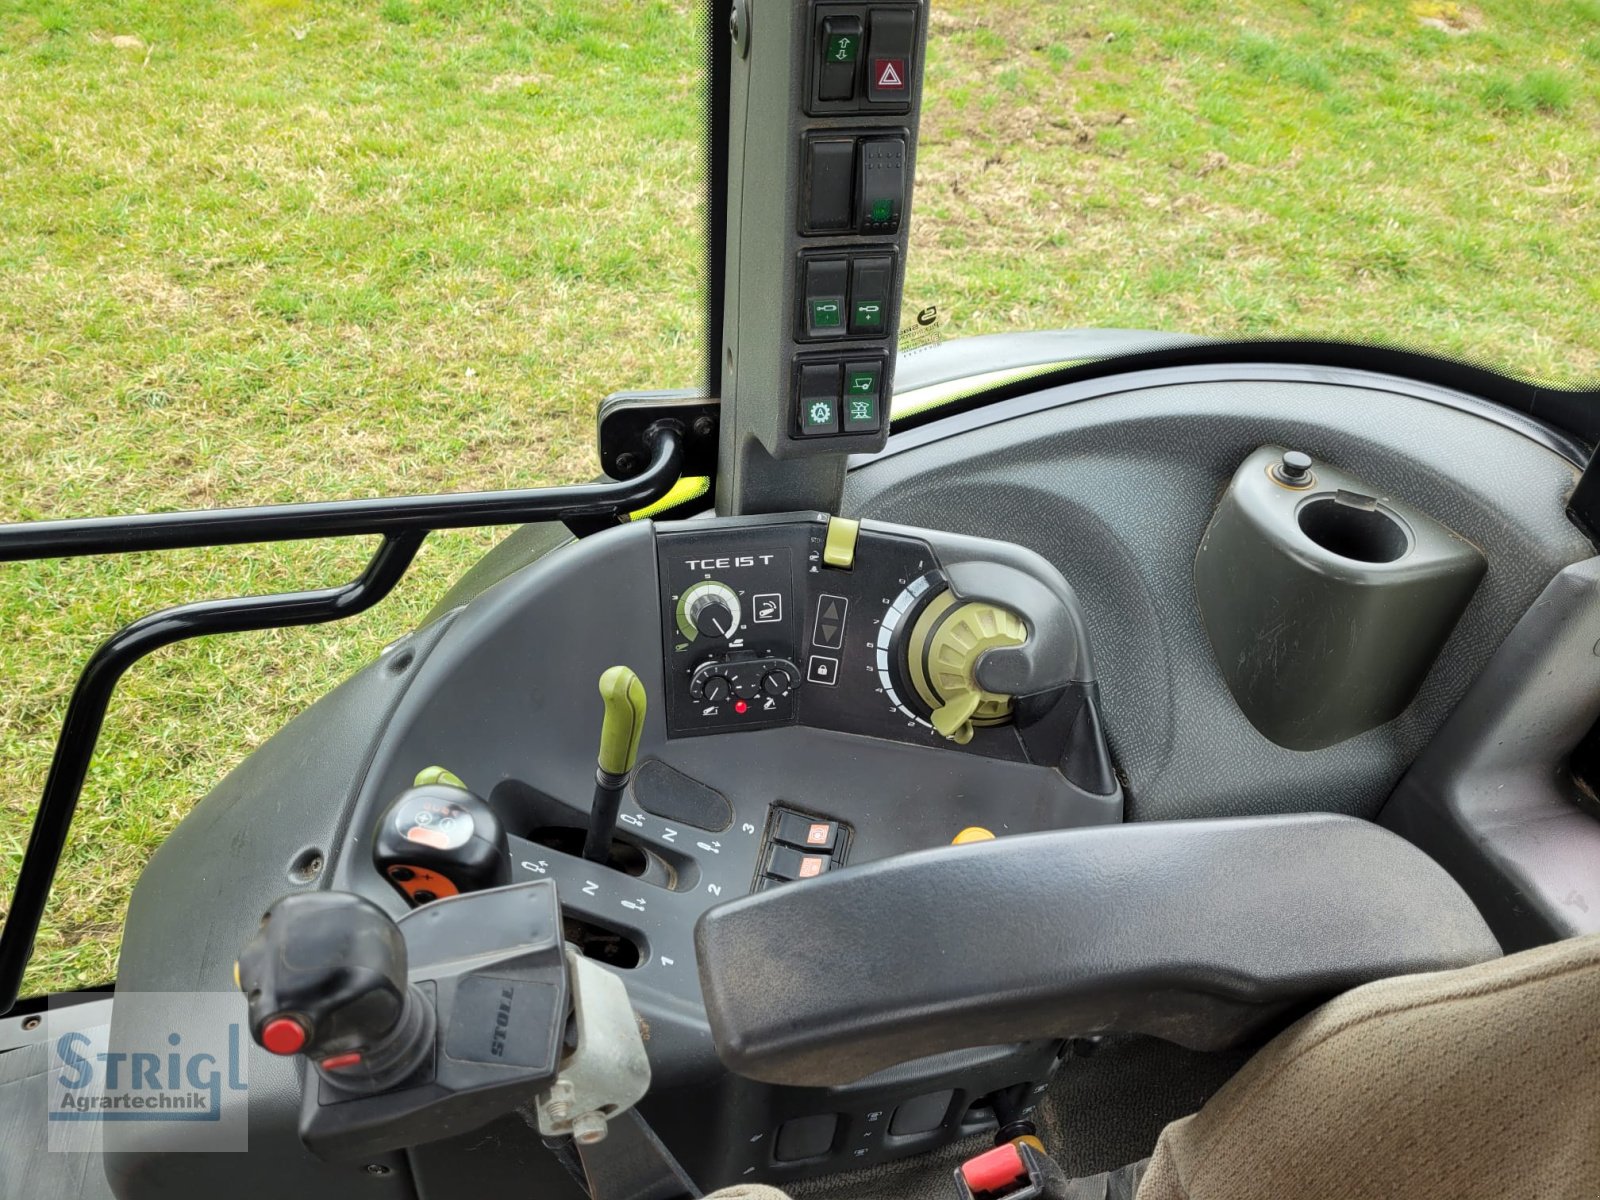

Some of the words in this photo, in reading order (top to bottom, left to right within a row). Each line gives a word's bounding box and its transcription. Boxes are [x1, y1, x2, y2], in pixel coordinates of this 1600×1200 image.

[816, 407, 824, 416] A
[685, 558, 730, 571] TCE
[759, 555, 774, 566] T
[662, 827, 678, 843] N
[742, 822, 755, 834] 3
[582, 880, 599, 896] N
[708, 883, 722, 896] 2
[661, 956, 674, 967] 1
[491, 987, 514, 1057] STOLL
